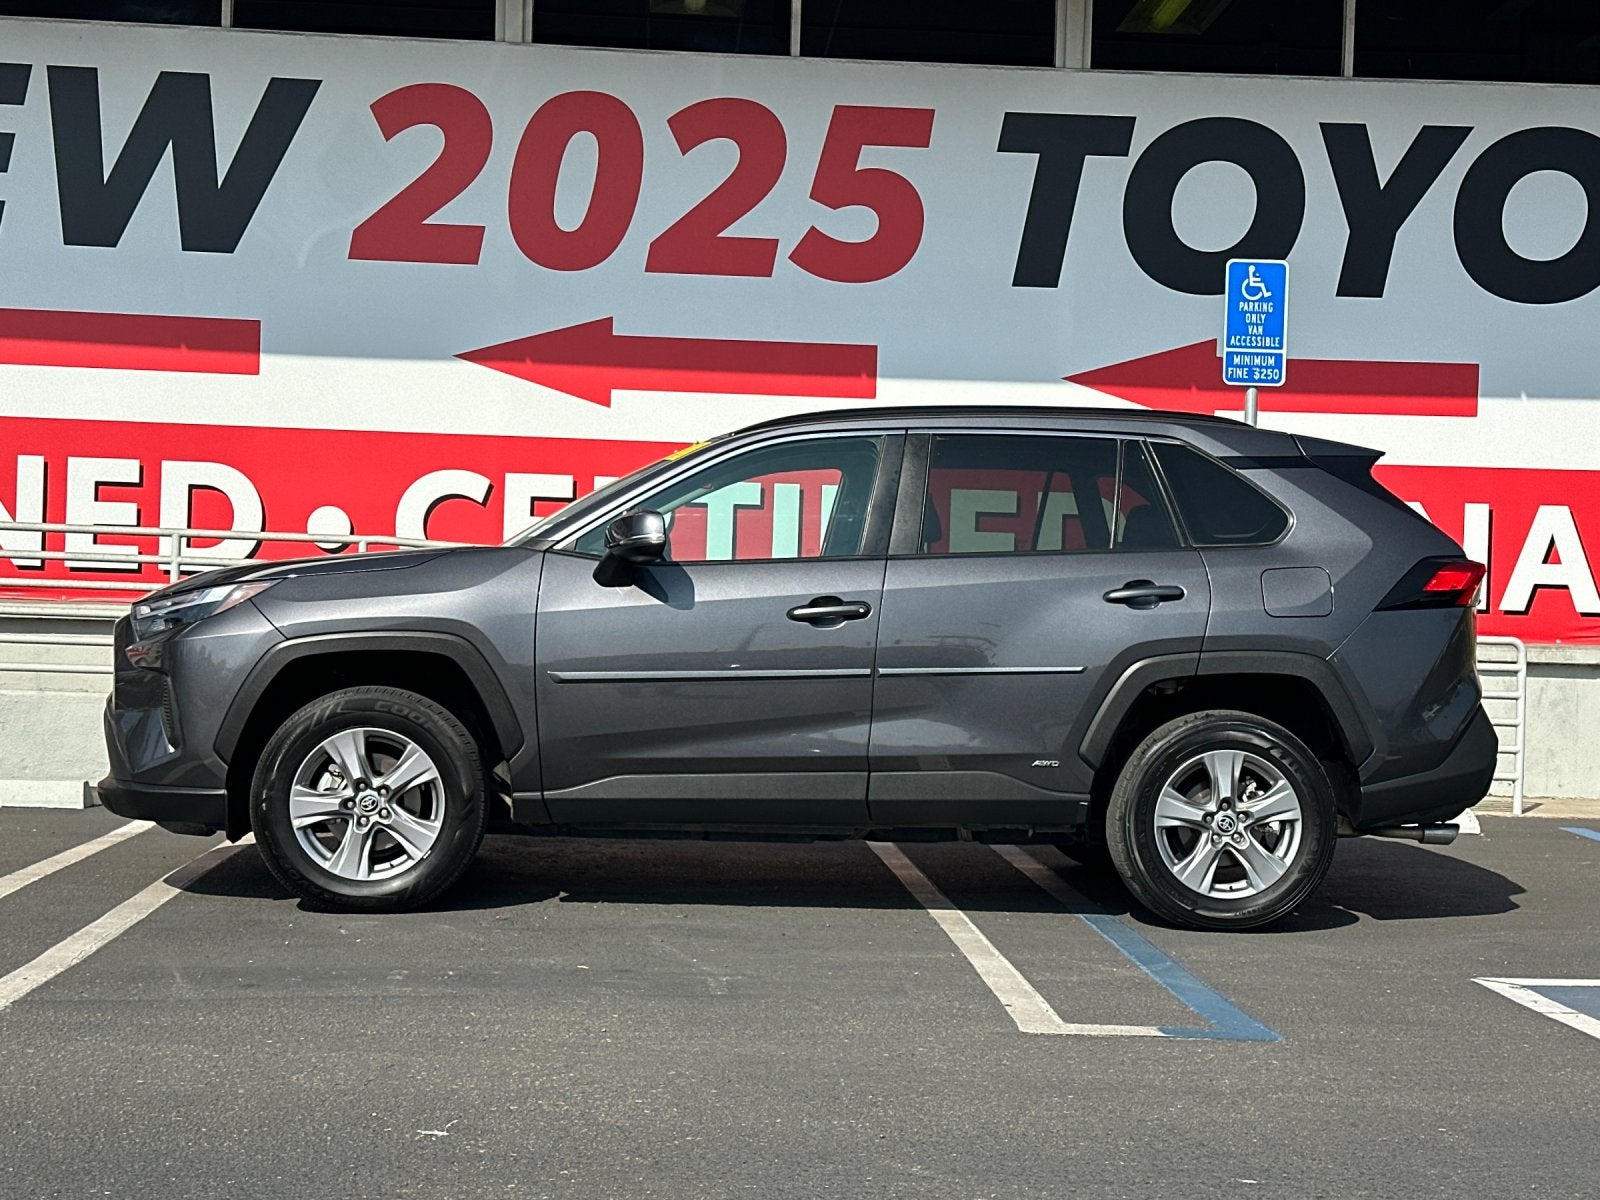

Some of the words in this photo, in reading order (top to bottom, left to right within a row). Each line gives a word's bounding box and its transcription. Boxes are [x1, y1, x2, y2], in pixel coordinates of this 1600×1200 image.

[348, 83, 935, 284] 2025
[997, 111, 1600, 305] TOYO
[1239, 302, 1273, 312] PARKING
[1245, 314, 1266, 323] ONLY
[1248, 326, 1263, 335] VAN
[1230, 336, 1279, 347] ACCESSIBLE
[1233, 354, 1274, 366] MINIMUM
[1228, 367, 1248, 378] FINE
[1253, 367, 1279, 380] $250
